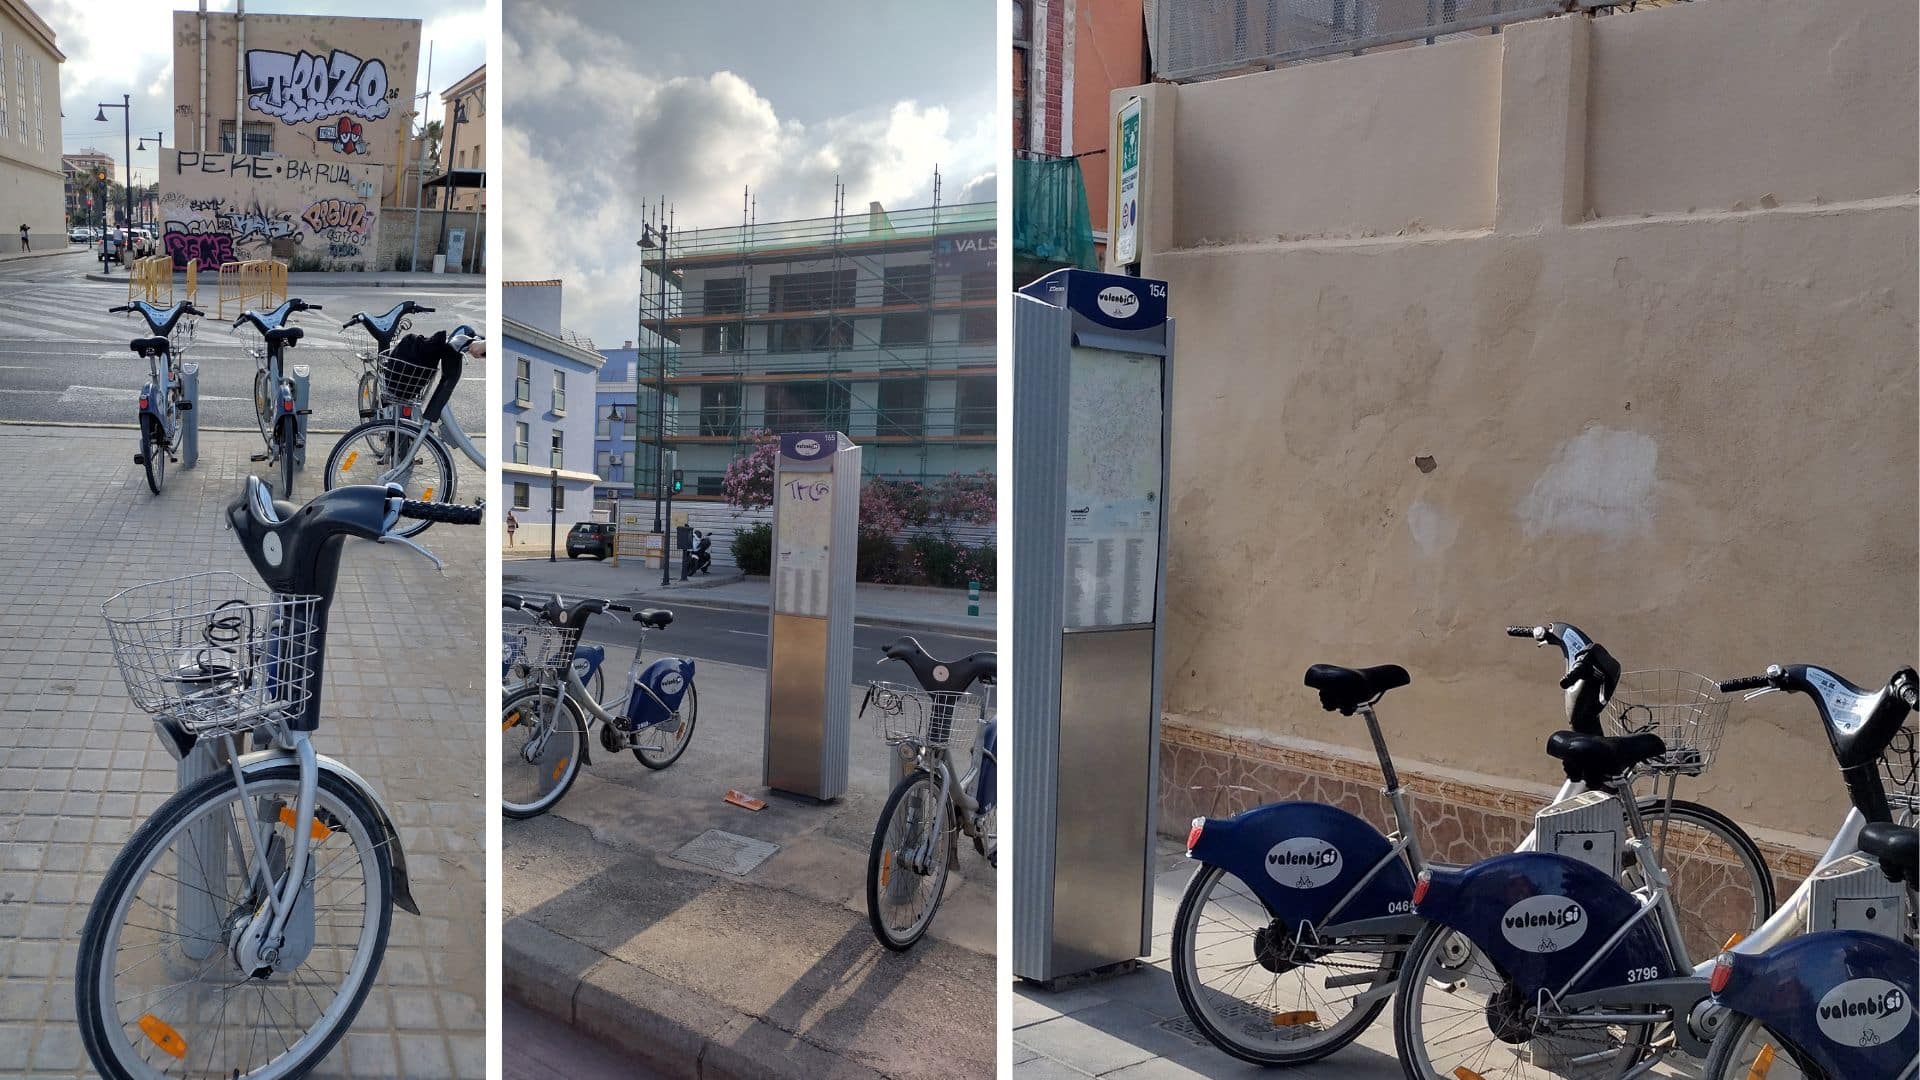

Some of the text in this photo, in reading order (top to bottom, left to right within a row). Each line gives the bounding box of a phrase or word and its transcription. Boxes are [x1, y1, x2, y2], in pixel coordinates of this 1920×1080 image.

[245, 48, 389, 115] TROZO
[177, 150, 273, 179] PEKE
[1149, 283, 1166, 298] 154
[1268, 848, 1338, 869] valenbisi
[1505, 904, 1581, 930] valenbisi
[1627, 965, 1659, 983] 3796
[1820, 988, 1905, 1020] valenbisi
